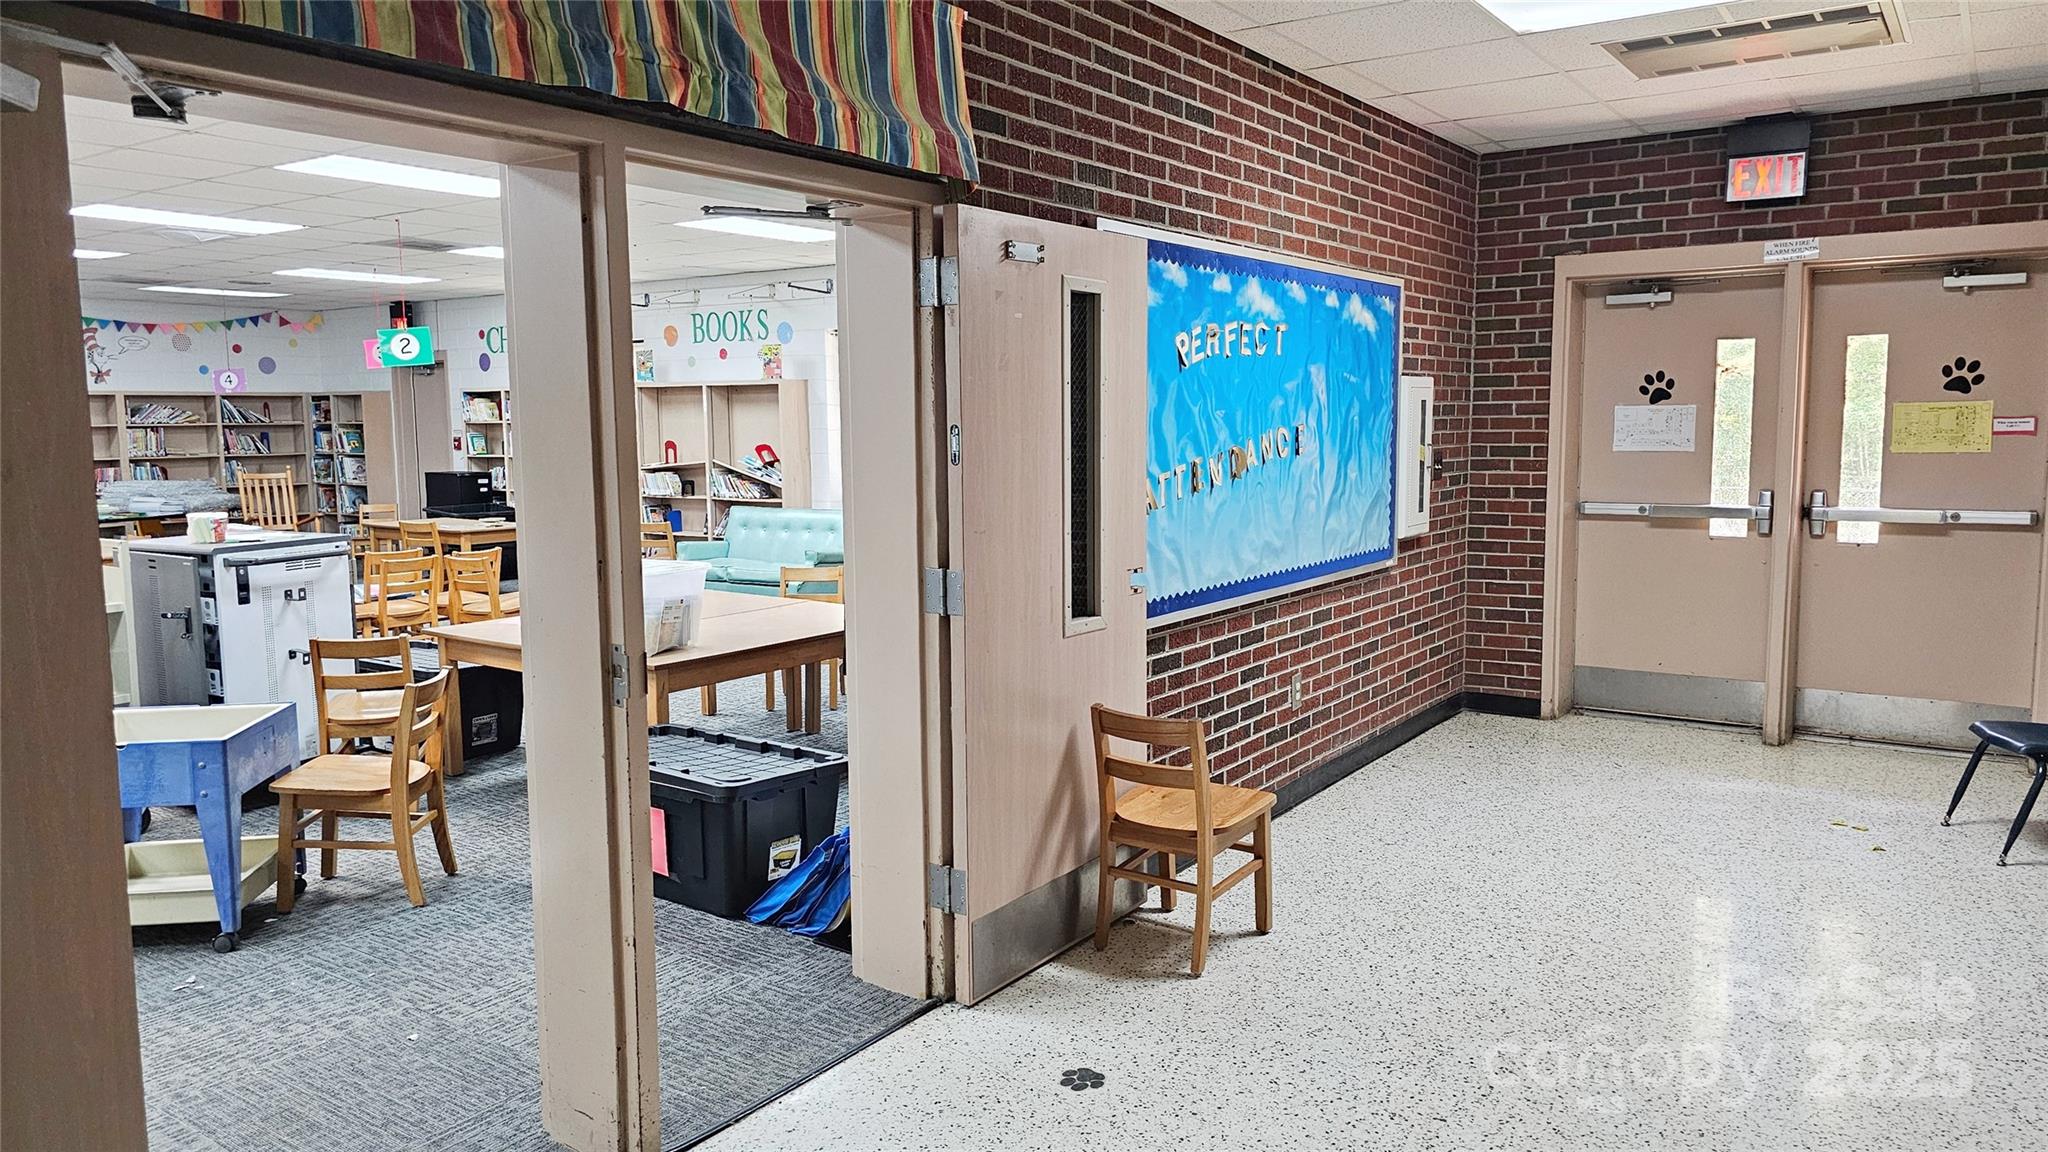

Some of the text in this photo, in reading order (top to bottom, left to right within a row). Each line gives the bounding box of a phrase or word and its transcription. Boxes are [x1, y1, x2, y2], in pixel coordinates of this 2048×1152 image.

[1732, 155, 1804, 198] EXIT
[1766, 246, 1819, 256] ALARM SOUNDS
[691, 309, 769, 345] BOOKS
[400, 337, 413, 354] 2
[1174, 320, 1289, 371] PERFECT
[224, 374, 233, 386] 4
[1146, 423, 1306, 513] ATTENDANCE
